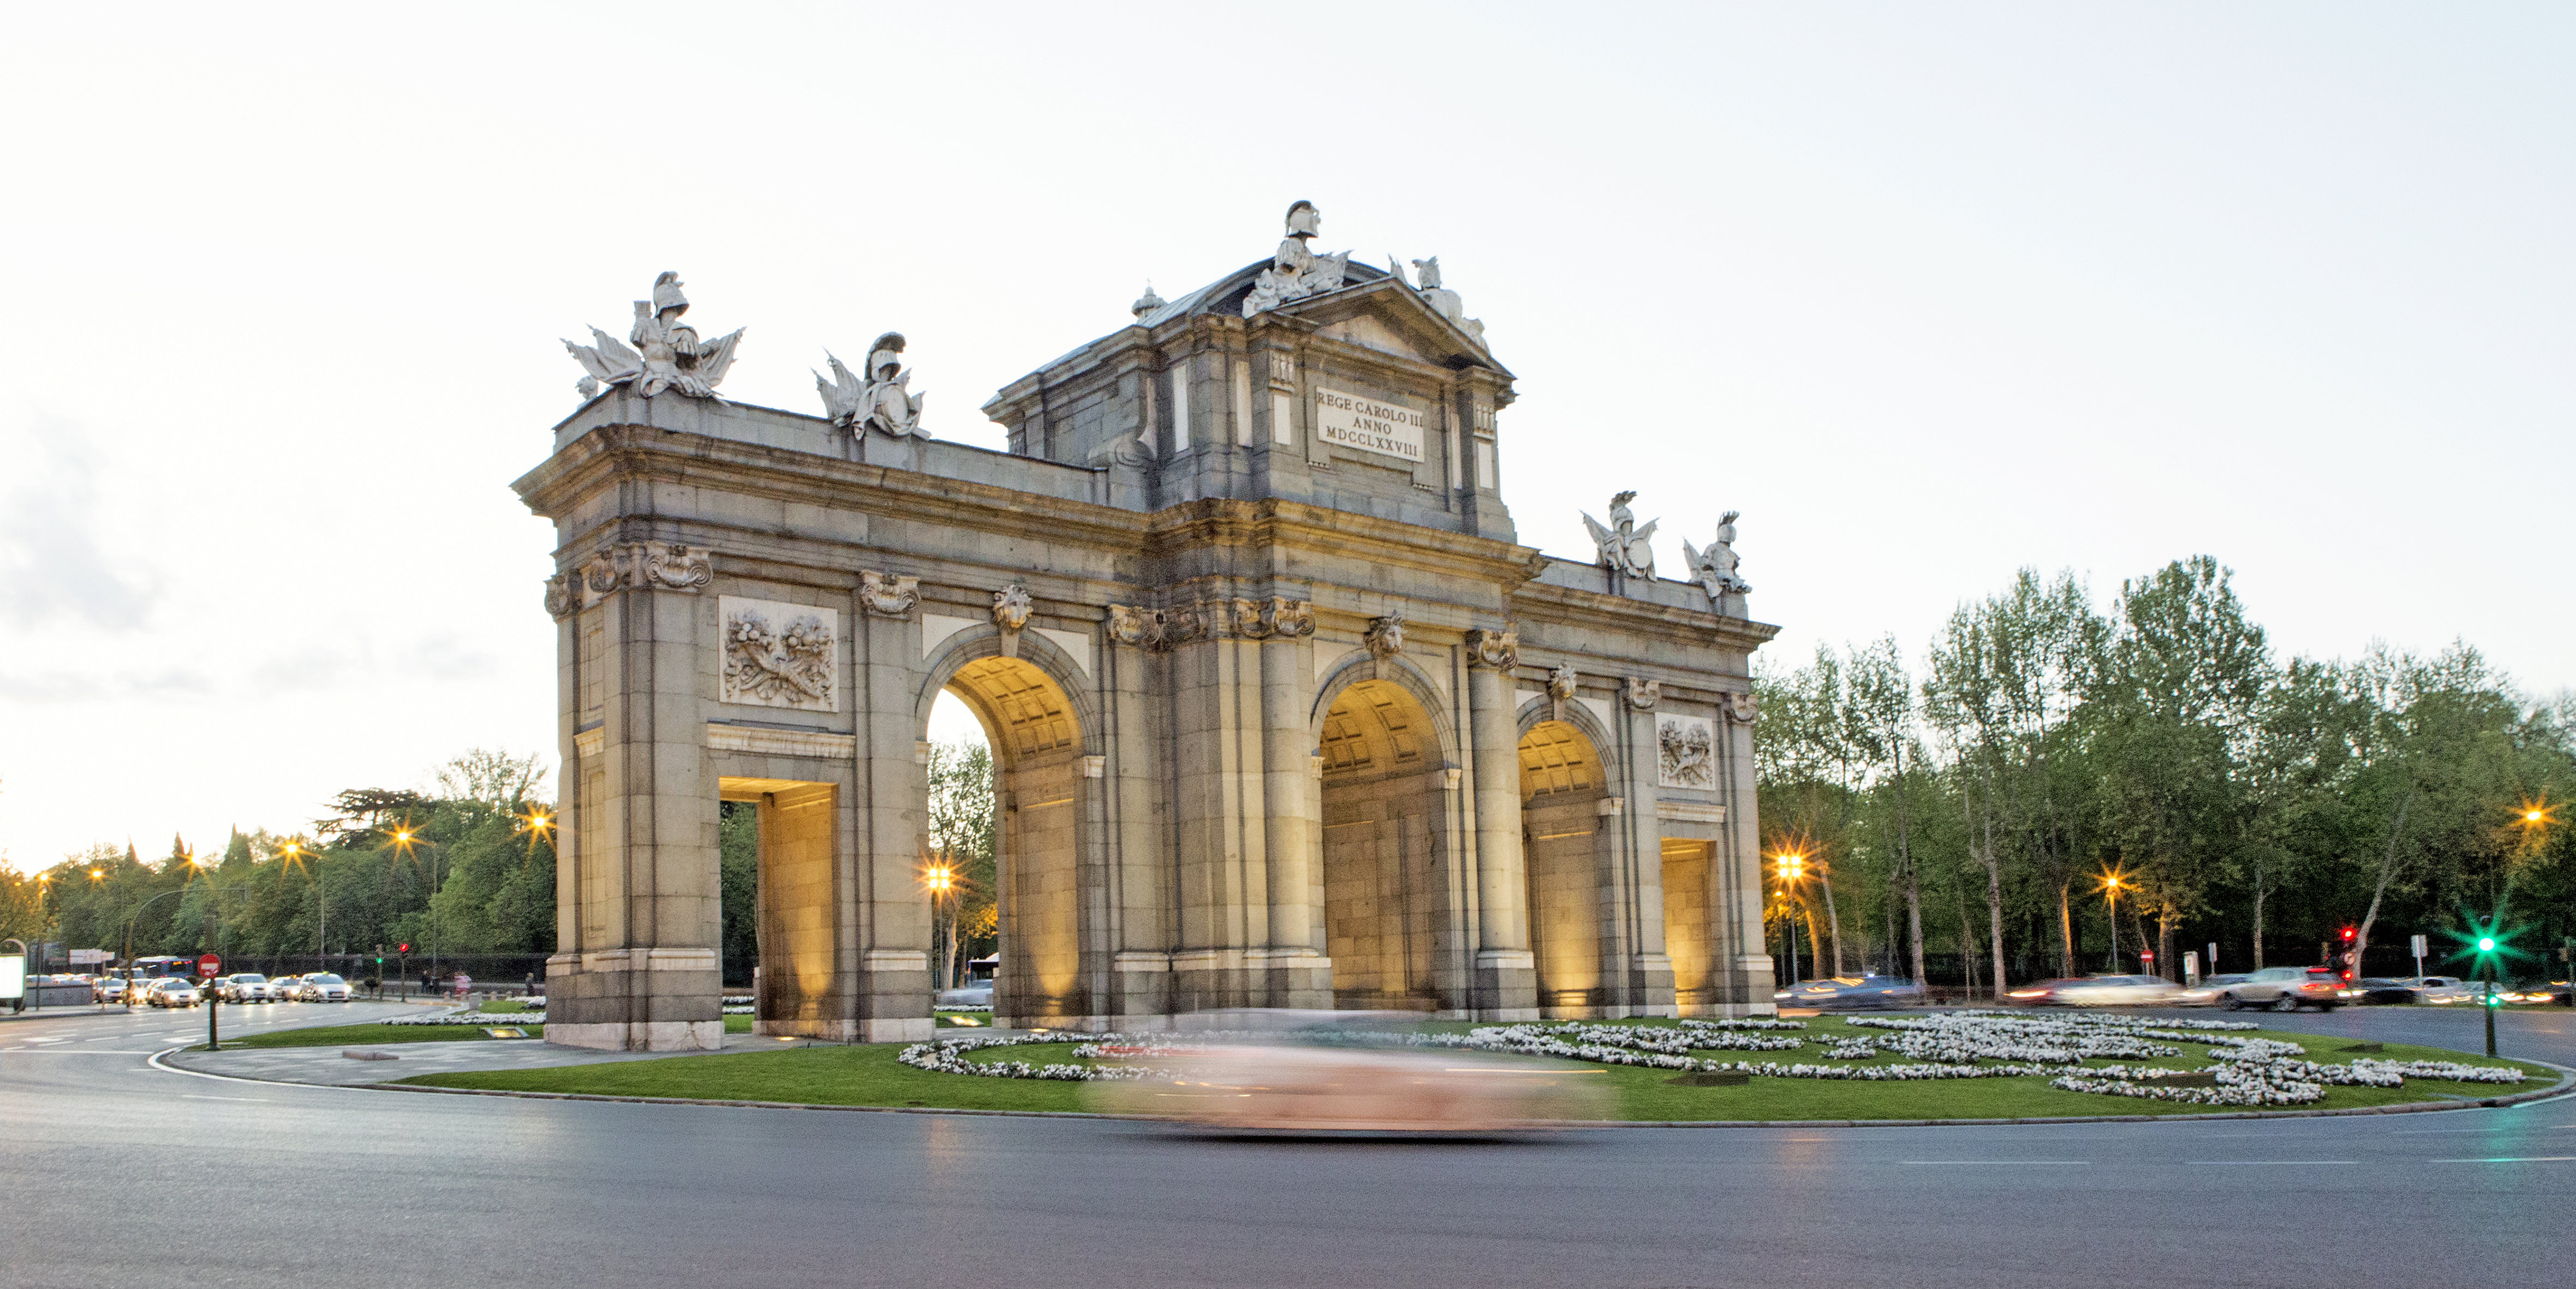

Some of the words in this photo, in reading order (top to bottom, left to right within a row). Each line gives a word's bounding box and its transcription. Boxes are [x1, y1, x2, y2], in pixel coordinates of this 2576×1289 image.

[1317, 392, 1351, 410] REGE
[1356, 402, 1406, 423] CAROLO
[1410, 414, 1423, 427] III
[1353, 416, 1391, 434] ANNO
[1327, 425, 1417, 456] MDCCLXXVIII
